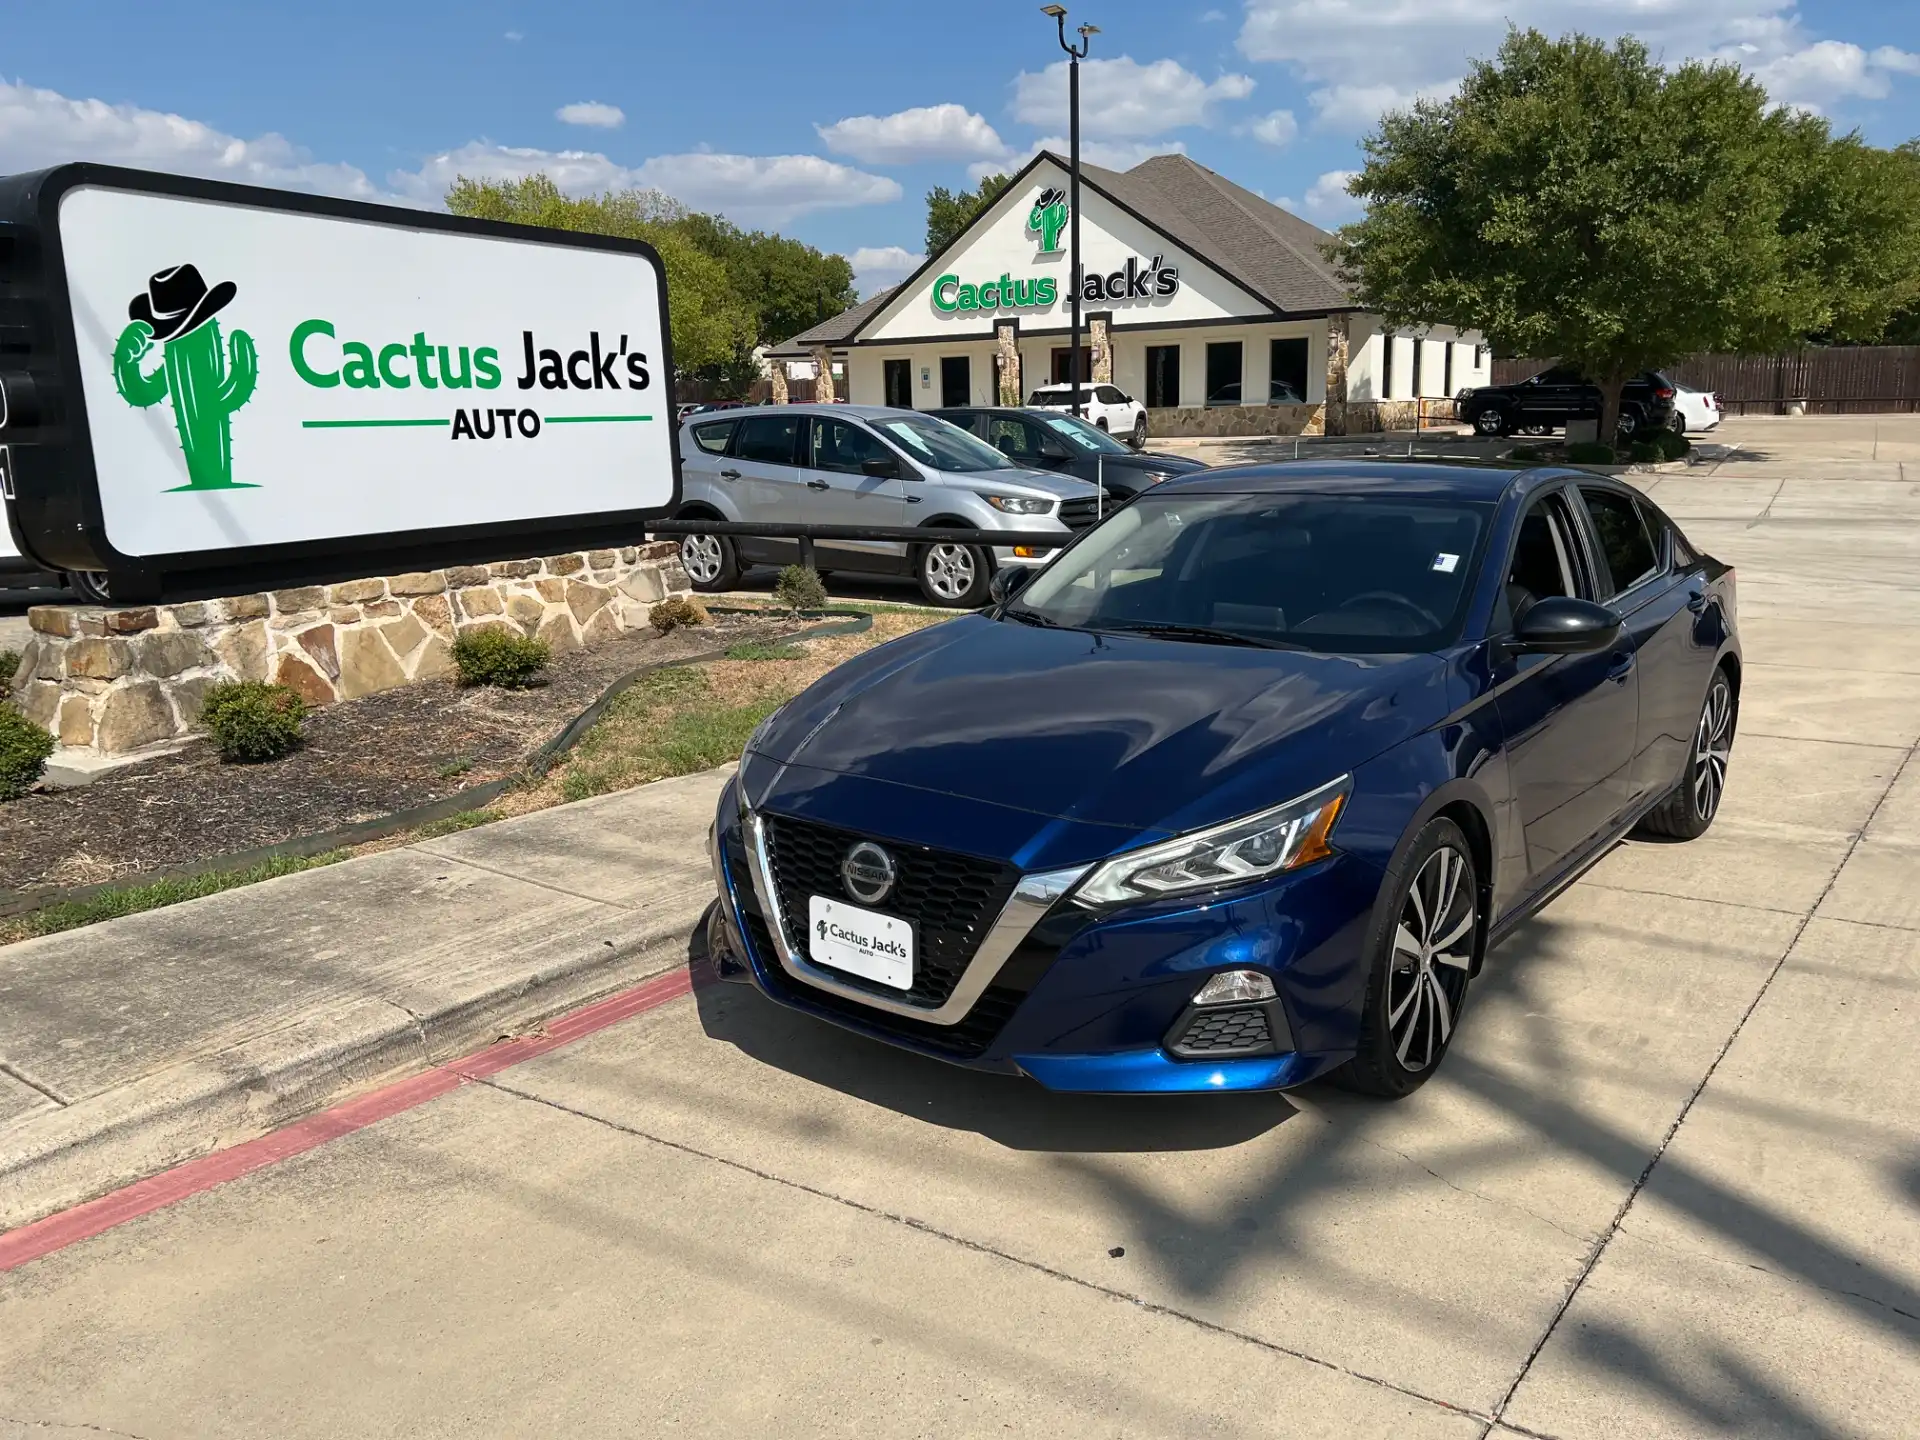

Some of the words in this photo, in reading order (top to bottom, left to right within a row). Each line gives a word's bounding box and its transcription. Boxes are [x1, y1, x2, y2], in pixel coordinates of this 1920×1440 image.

[931, 272, 1057, 312] Cactus
[289, 319, 502, 389] Cactus
[517, 331, 651, 390] Jack's
[451, 408, 541, 440] AUTO
[847, 862, 888, 881] NISSAN
[829, 923, 869, 947] Cactus
[871, 936, 907, 958] Jack's
[858, 948, 874, 957] AUTO
